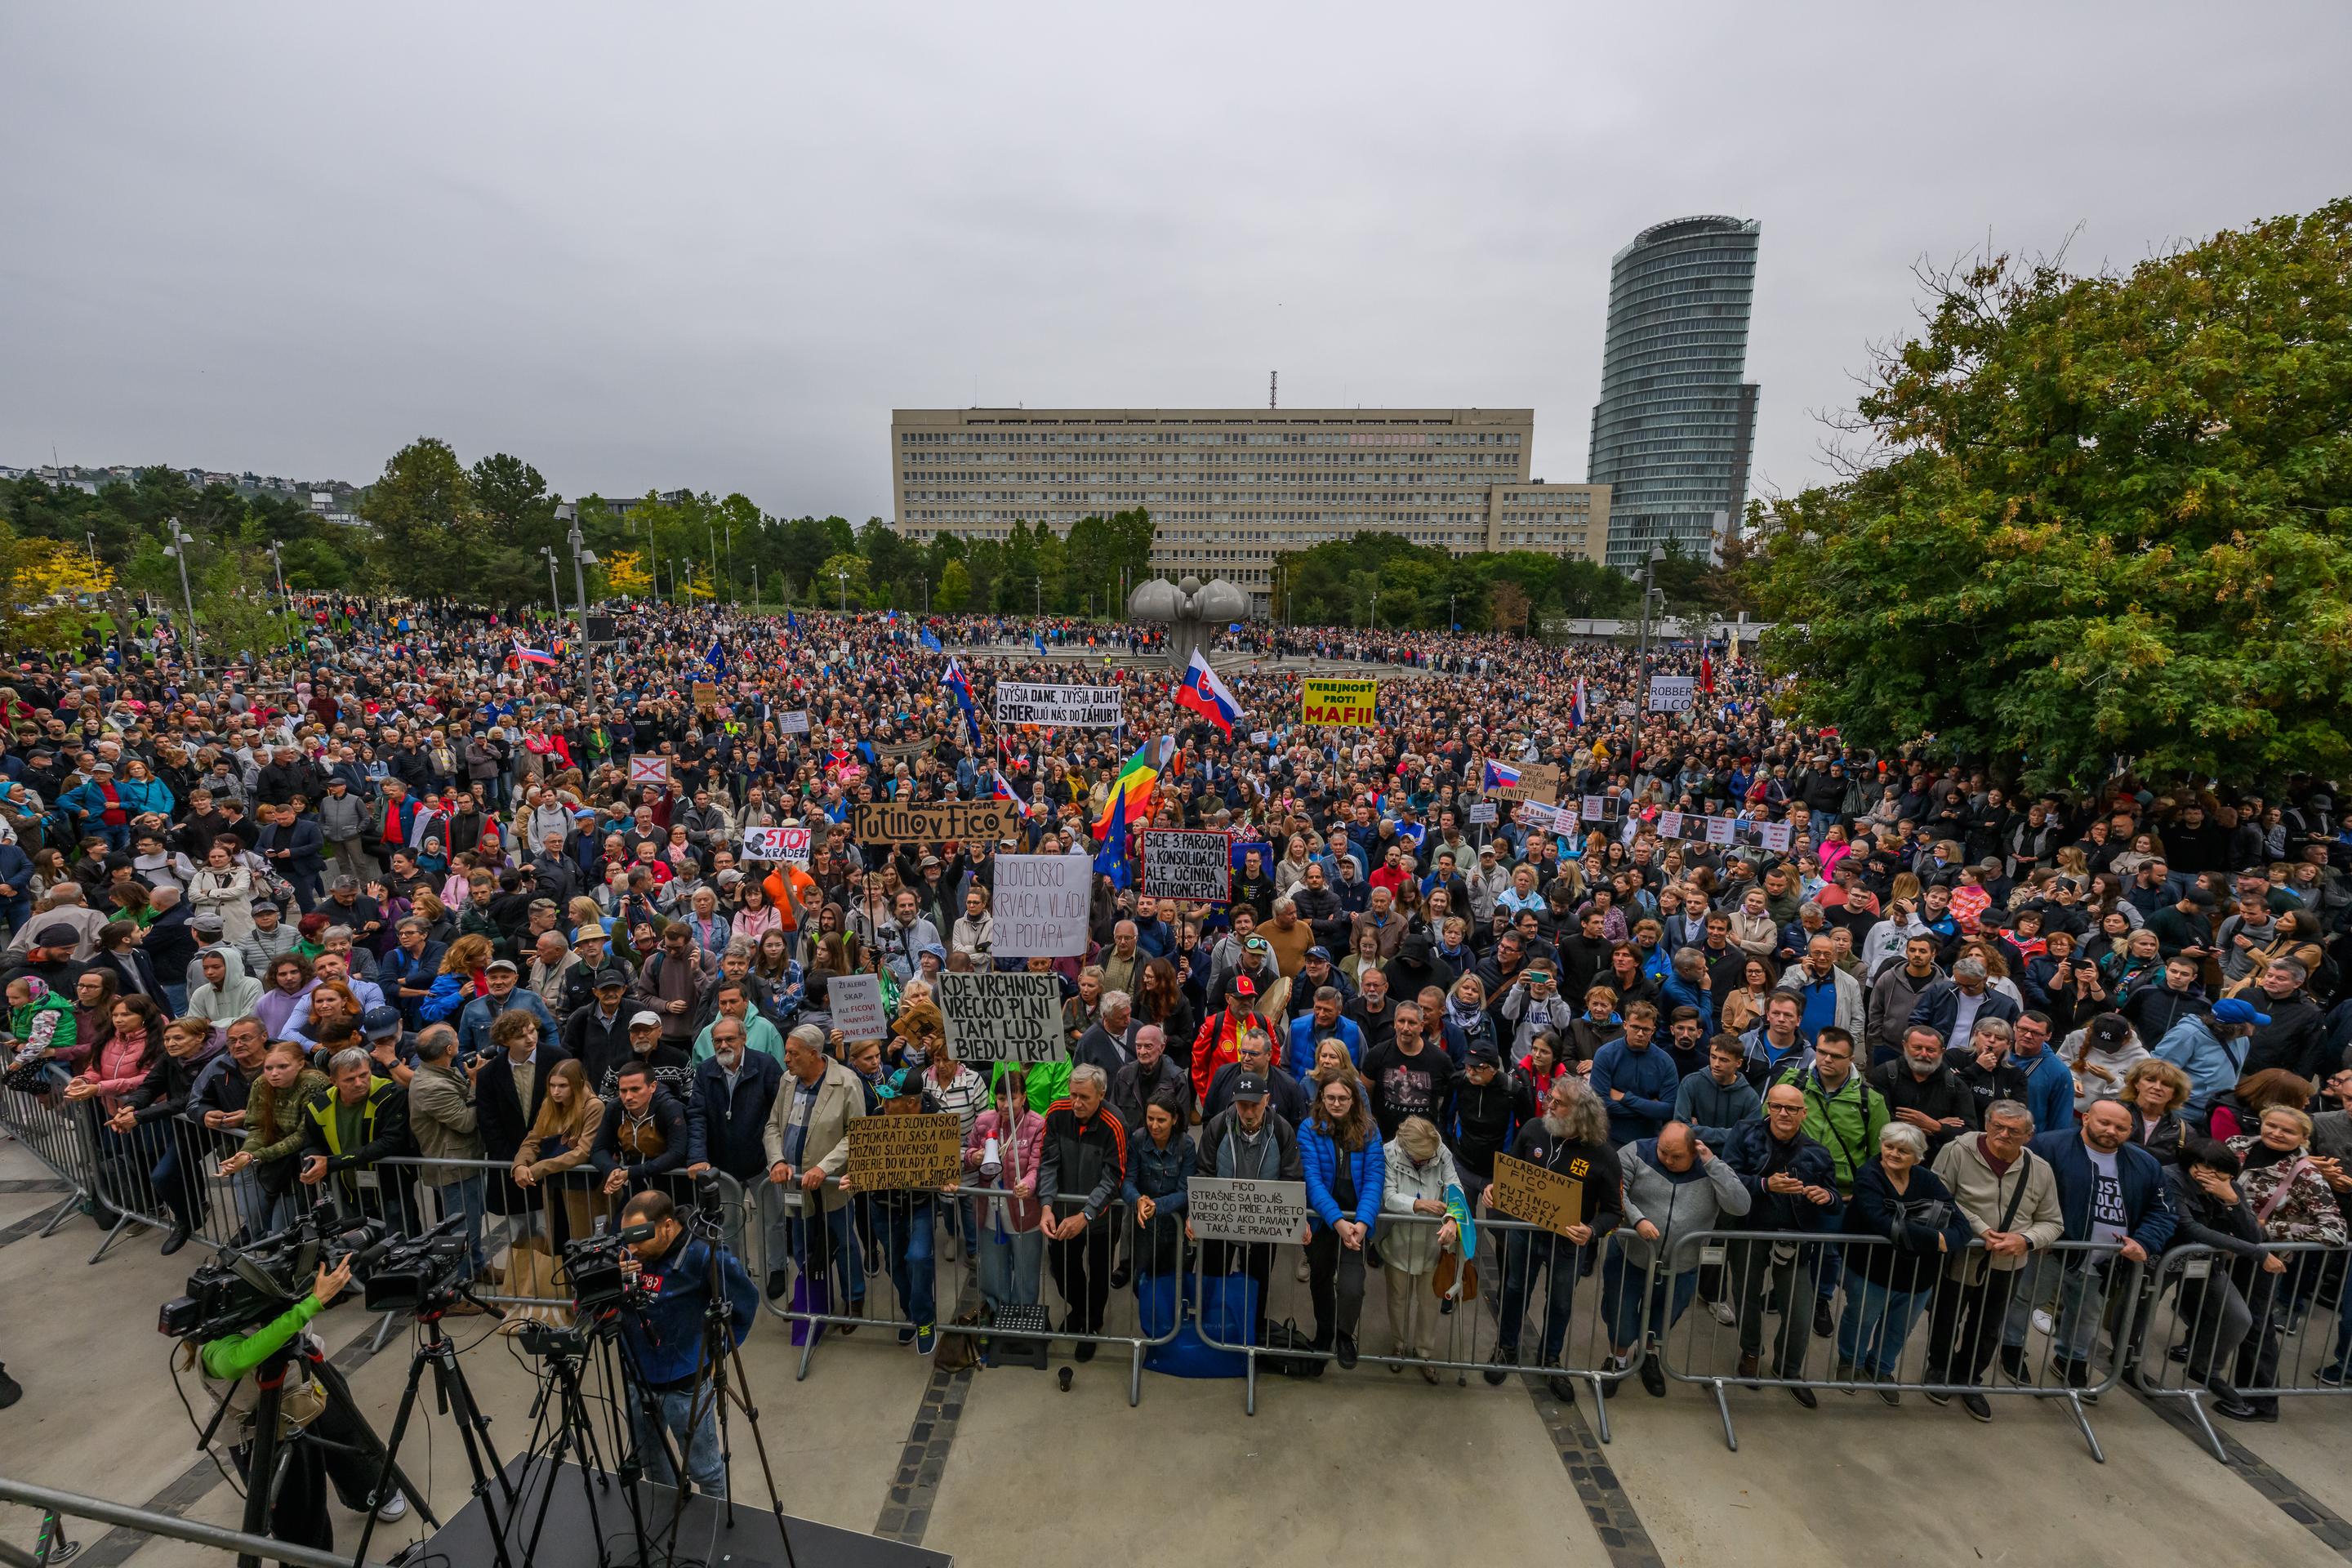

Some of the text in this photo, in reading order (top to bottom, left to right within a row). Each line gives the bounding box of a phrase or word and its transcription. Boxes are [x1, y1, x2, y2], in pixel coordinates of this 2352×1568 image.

[999, 686, 1120, 706] ZVÝŠIA DANE, ZVÝŠIA DLHY,
[1651, 687, 1692, 696] ROBBER
[1651, 699, 1690, 710] FICO
[1051, 706, 1067, 721] NÁS
[1069, 710, 1080, 721] DO
[1081, 705, 1119, 723] ZÁHUBY
[1306, 706, 1372, 723] MAFII
[765, 829, 811, 849] STOP
[1145, 853, 1156, 863] NA
[994, 862, 1064, 887] SLOVENSKO
[1145, 866, 1217, 883] ALE ÚČINNÁ
[1145, 882, 1227, 899] ANTIKONCEPCIA
[1049, 890, 1085, 918] VLÁDA
[992, 921, 1063, 947] SA POTÁPA
[838, 981, 845, 989] ŽI
[940, 972, 1057, 997] KDE VRCHNOSŤ
[850, 1004, 875, 1012] FICOVI
[942, 996, 1055, 1020] VRECKO PLNÍ
[952, 1019, 1043, 1040] TAM ĽUD
[955, 1034, 1058, 1062] BIEDU TRPÍ
[892, 1117, 902, 1129] JE
[903, 1116, 958, 1129] SLOVENSKO
[930, 1130, 936, 1142] A
[884, 1143, 938, 1156] SLOVENSKO
[849, 1157, 884, 1172] ZOBERIE
[885, 1157, 897, 1169] DO
[927, 1156, 938, 1168] AJ
[943, 1155, 956, 1166] PS
[1499, 1155, 1575, 1189] KOLABORANT
[849, 1174, 862, 1184] ALE
[863, 1172, 874, 1183] TO
[1510, 1169, 1547, 1190] FICO
[1232, 1182, 1255, 1192] FICO
[1192, 1190, 1283, 1204] STRAŠNE SA BOJÍŠ
[1499, 1183, 1561, 1212] PUTINOV
[2096, 1193, 2123, 1209] OLO
[1192, 1201, 1218, 1211] TOHO
[1222, 1202, 1236, 1212] ČO
[1266, 1205, 1272, 1214] A
[1274, 1205, 1304, 1216] PRETO
[2095, 1205, 2124, 1222] ICA!
[1192, 1212, 1234, 1223] VRIESKAŠ
[1237, 1215, 1255, 1224] AKO
[1205, 1223, 1230, 1233] TAKÁ
[1233, 1226, 1245, 1235] JE
